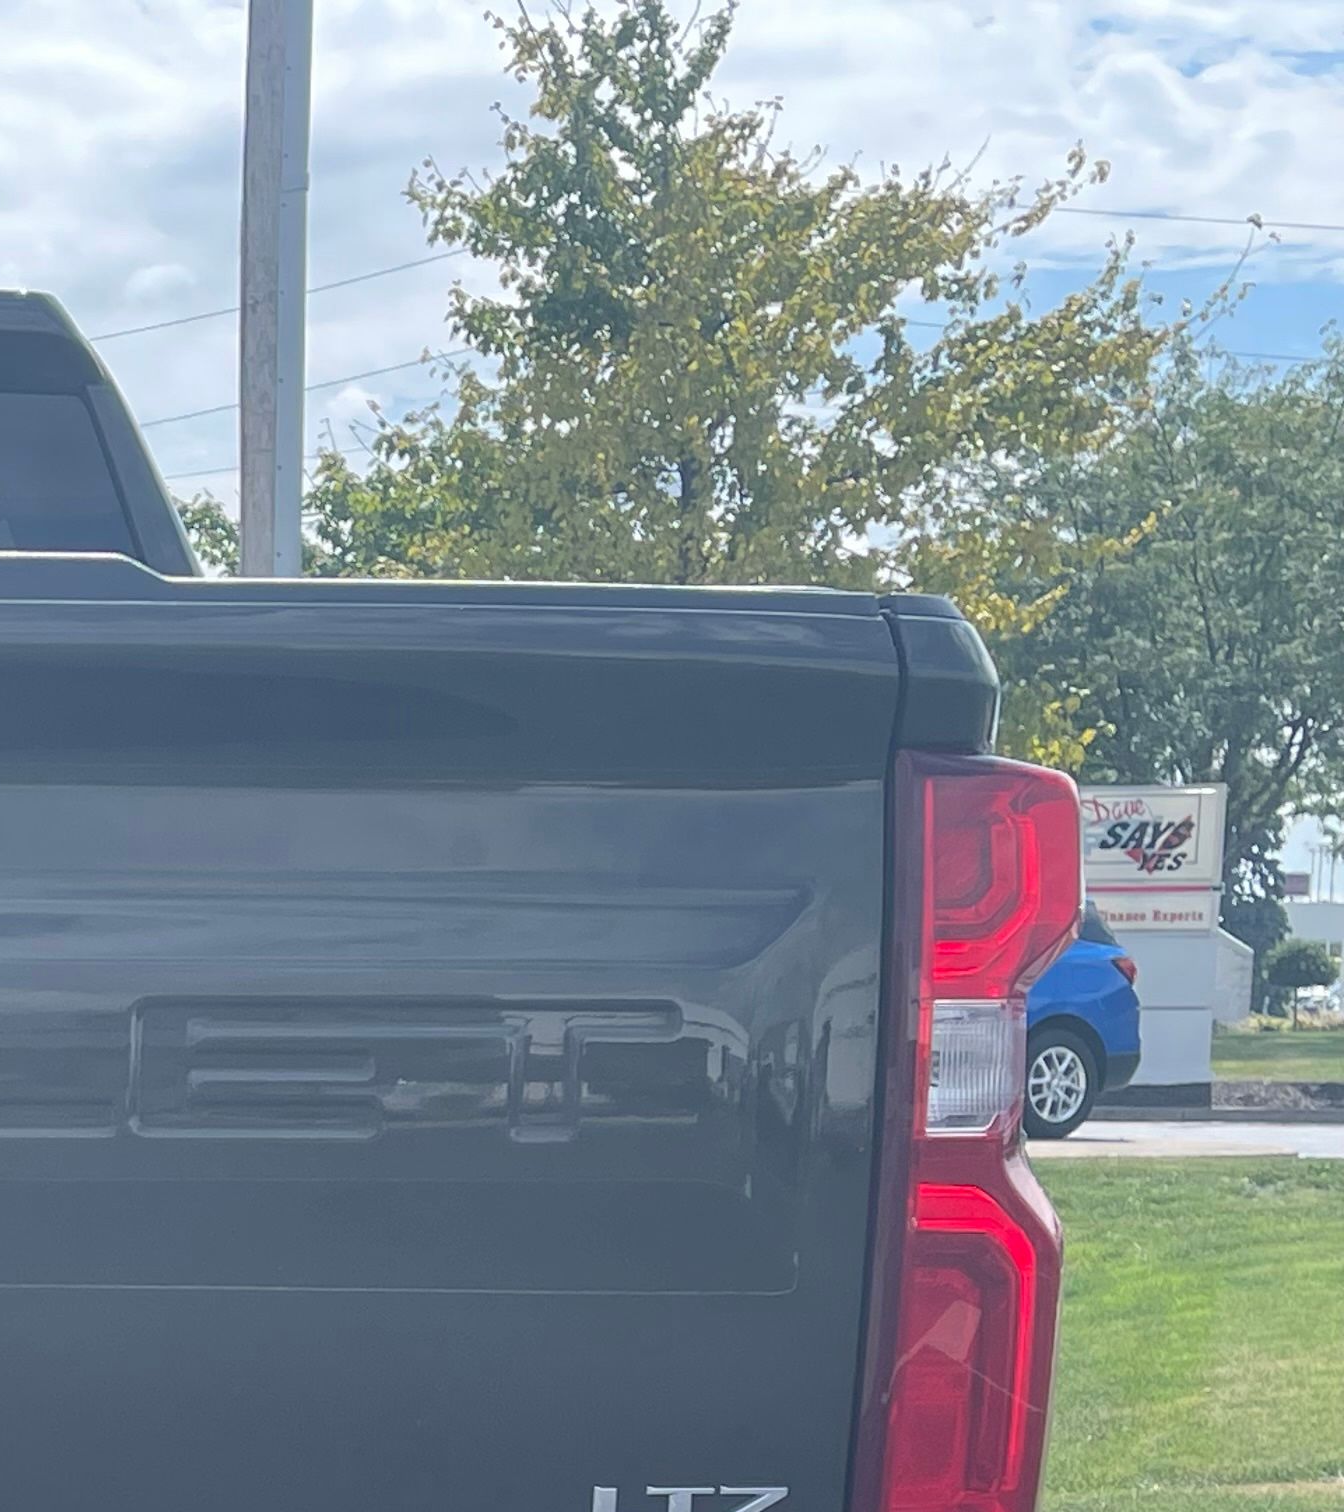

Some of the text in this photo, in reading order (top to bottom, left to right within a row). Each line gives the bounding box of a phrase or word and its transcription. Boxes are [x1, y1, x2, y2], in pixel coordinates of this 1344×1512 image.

[1081, 798, 1146, 825] Dave
[1099, 816, 1195, 850] SAYS
[1137, 852, 1188, 872] YES
[1152, 909, 1204, 924] Experts
